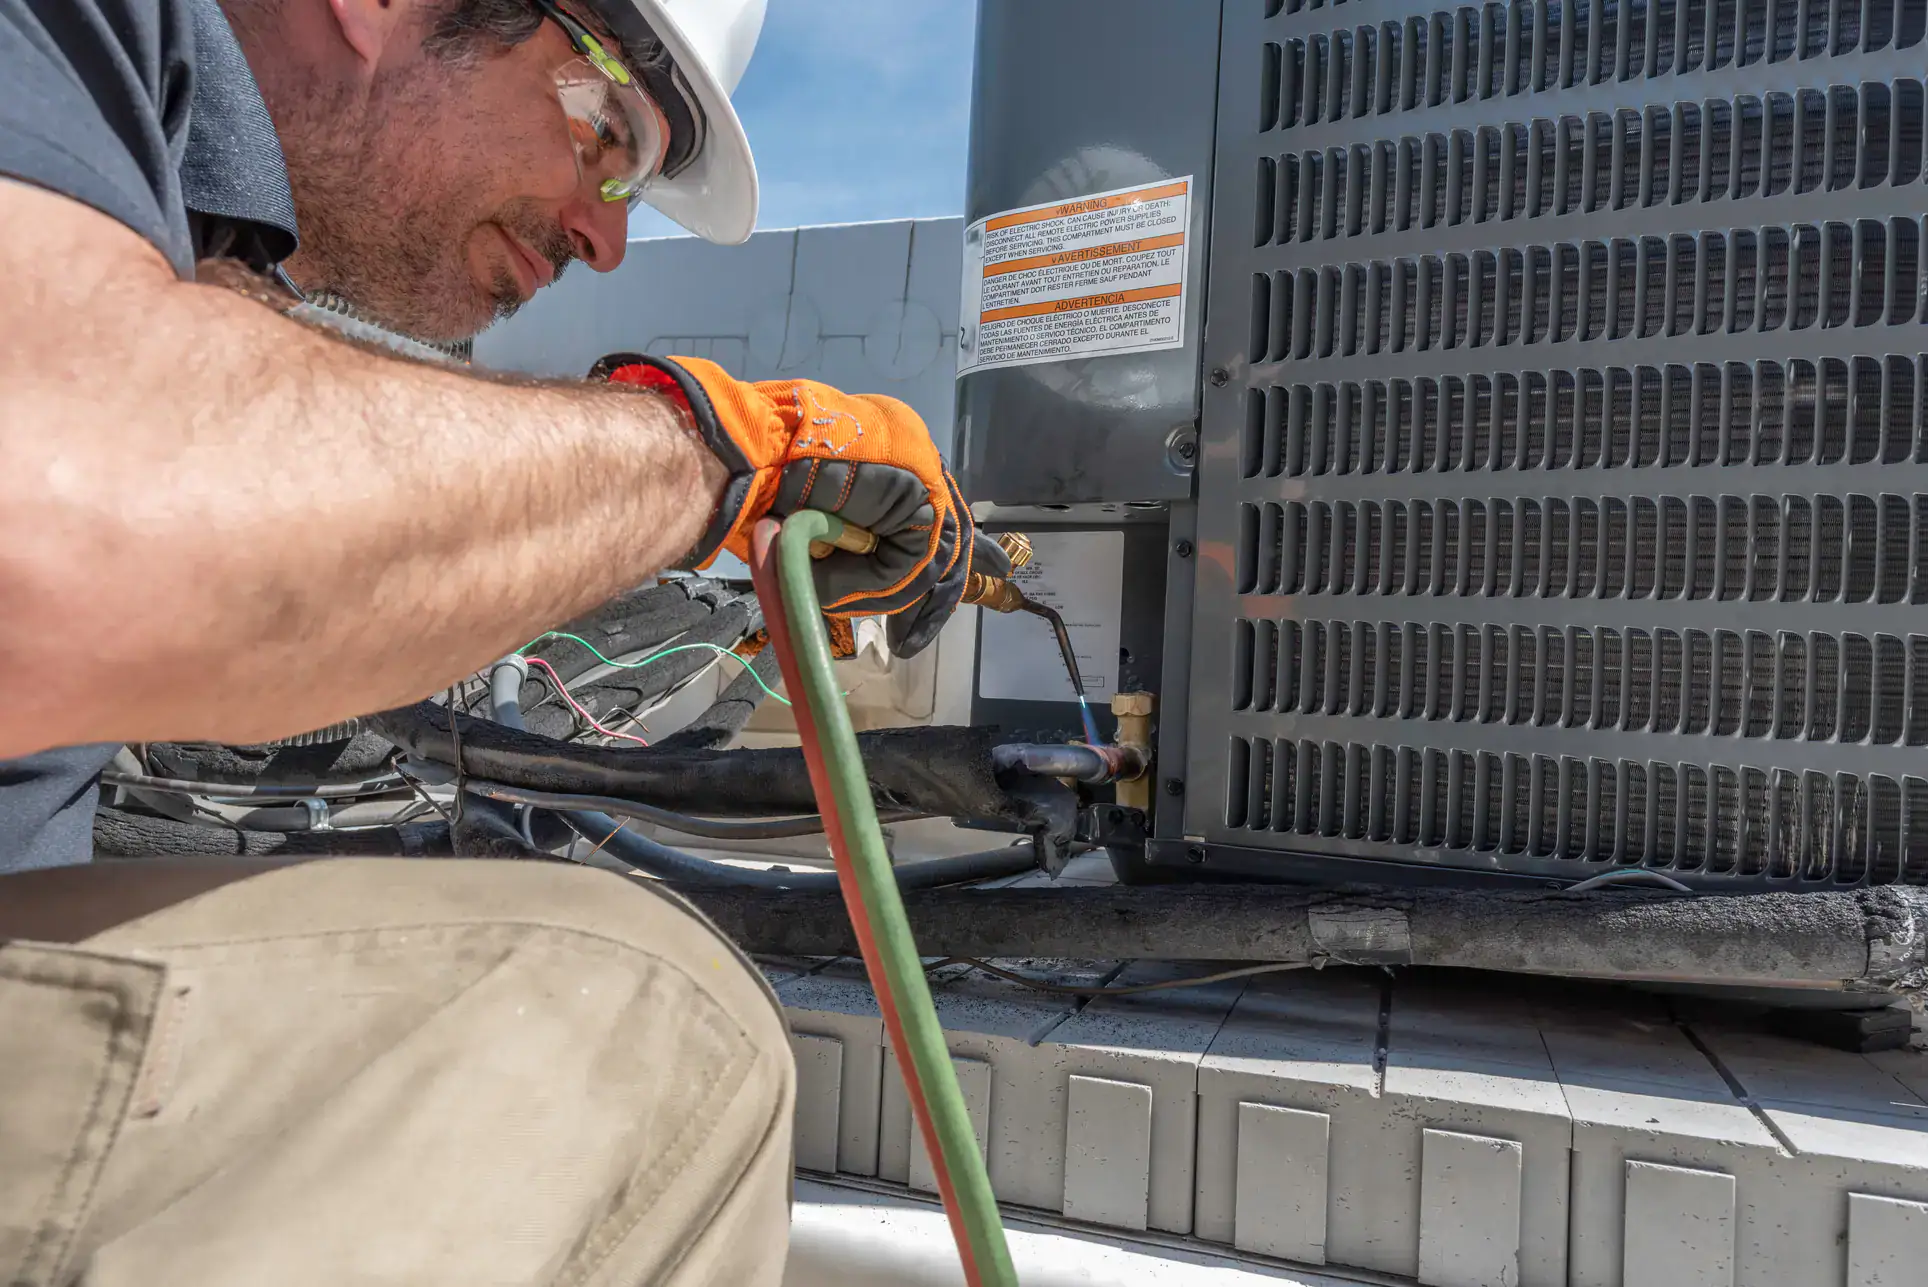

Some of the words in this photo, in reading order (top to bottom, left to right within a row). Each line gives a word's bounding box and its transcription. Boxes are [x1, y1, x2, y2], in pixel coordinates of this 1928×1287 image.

[986, 235, 1023, 248] DISCONNECT
[1038, 227, 1064, 237] REMOTE
[1066, 220, 1098, 232] ELECTRIC
[1100, 217, 1126, 227] POWER
[1127, 210, 1161, 222] SUPPLIES
[1010, 224, 1040, 235] ELECTRIC
[1082, 212, 1105, 221] CAUSE
[1107, 207, 1131, 217] INJURY
[986, 245, 1008, 256] BEFORE
[1047, 235, 1061, 244] THIS
[1062, 227, 1113, 241] COMPARTMENT
[1114, 224, 1134, 232] MUST
[1147, 216, 1176, 226] CLOSED
[984, 276, 1007, 286] DANGER
[1018, 270, 1037, 279] CHOC
[1038, 264, 1079, 276] ÉLECTRIQUE
[1102, 257, 1124, 266] MORT.
[1126, 252, 1155, 263] COUPEZ
[1157, 249, 1176, 258] TOUT
[986, 252, 1007, 263] EXCEPT
[1008, 249, 1027, 258] WHEN
[1029, 244, 1064, 255] SERVICING.
[983, 288, 1030, 302] COMPARTIMENT
[1031, 285, 1046, 294] DOIT
[1048, 281, 1073, 291] RESTER
[1075, 278, 1098, 287] FERME
[1100, 275, 1118, 284] SAUF
[1119, 270, 1152, 281] PENDANT
[991, 281, 1020, 293] COURANT
[1021, 279, 1042, 288] AVANT
[1044, 275, 1061, 284] TOUT
[1063, 270, 1100, 281] ENTRETIEN
[981, 322, 1006, 331] PELIGRO
[1017, 317, 1044, 326] CHOQUE
[1090, 307, 1121, 316] MUERTE.
[1123, 300, 1171, 312] DESCONECTE
[1055, 294, 1124, 311] ADVERTENCIA
[980, 335, 1028, 347] MANTENIMIENTO
[1036, 329, 1065, 339] SERVICO
[1109, 317, 1171, 331] COMPARTIMENTO
[980, 348, 994, 356] DEBE
[995, 341, 1038, 353] PERMANECER
[1040, 336, 1071, 346] CERRADO
[1073, 334, 1105, 343] EXCEPTO
[1106, 330, 1138, 339] DURANTE
[1014, 326, 1042, 335] FUENTES
[980, 353, 1006, 364] SERVICIO
[1016, 346, 1072, 358] MANTENIMIENTO.
